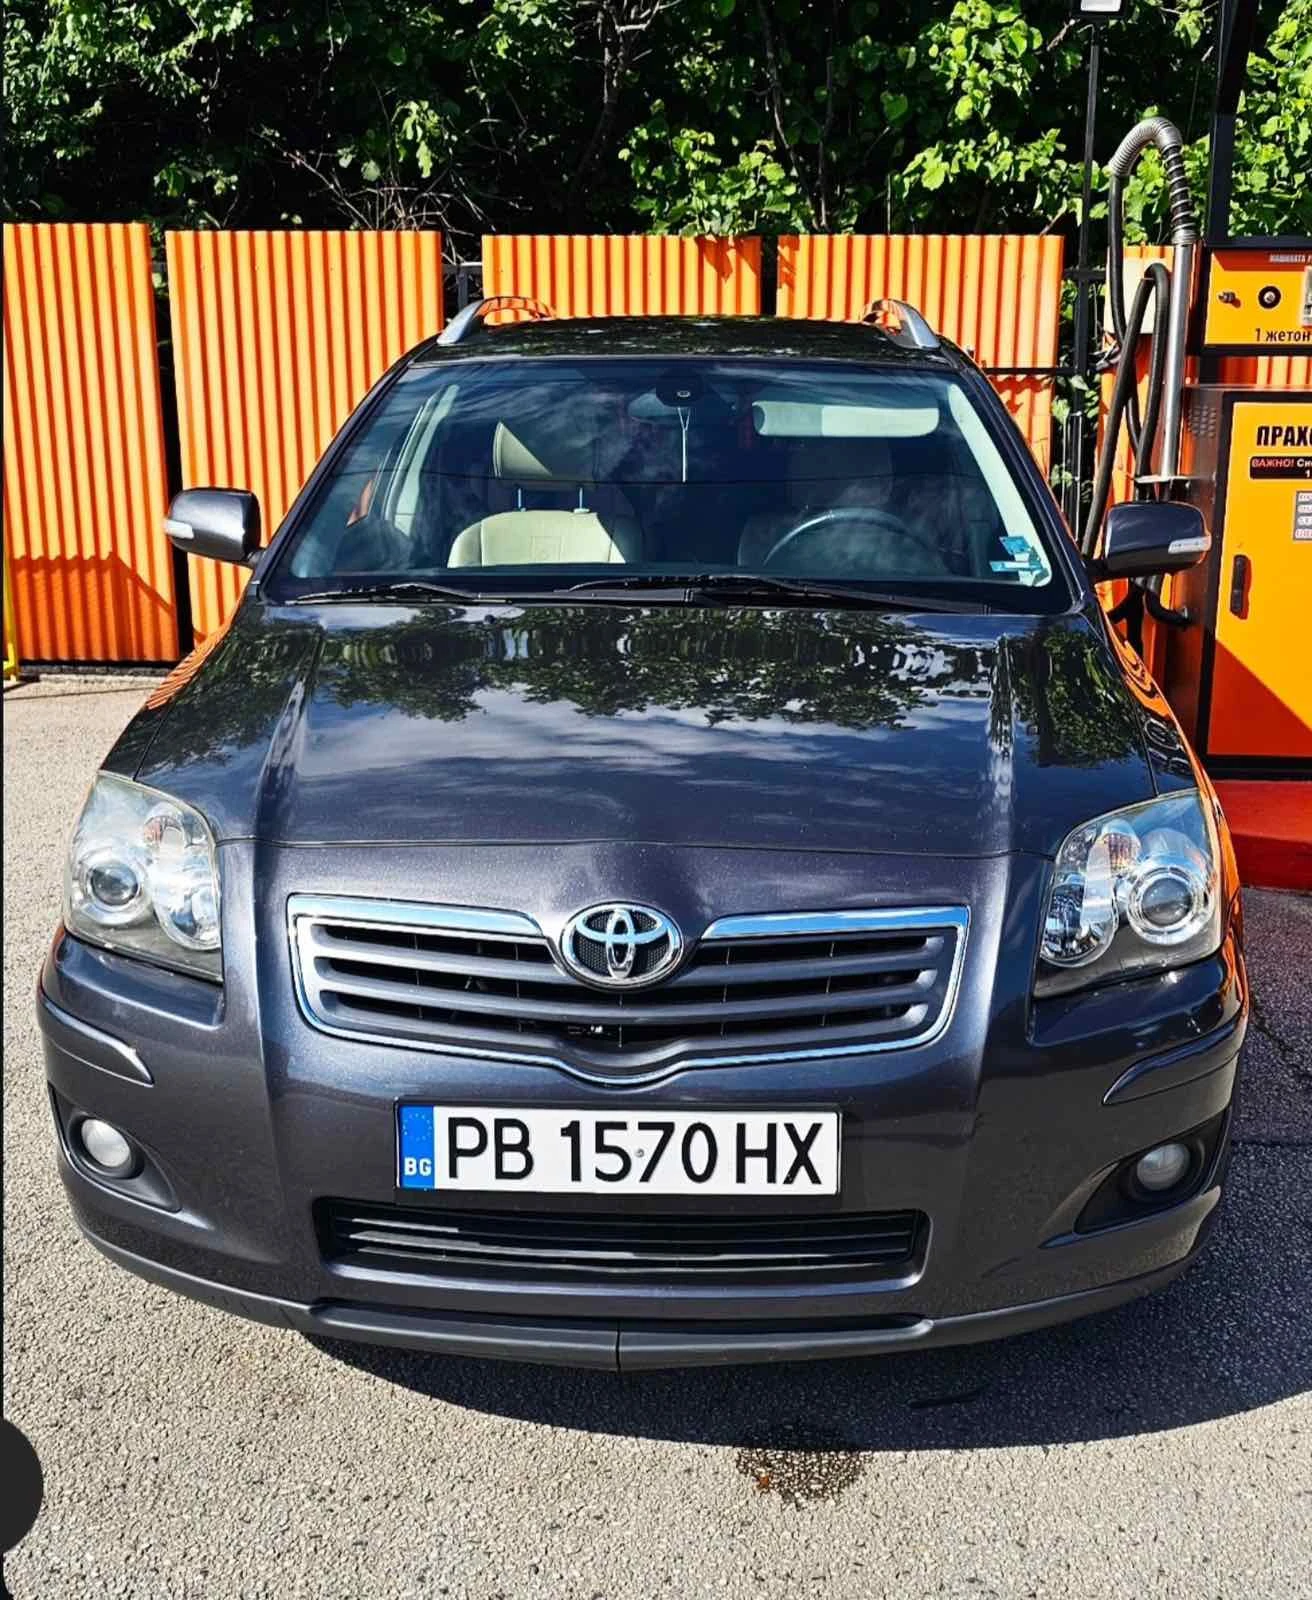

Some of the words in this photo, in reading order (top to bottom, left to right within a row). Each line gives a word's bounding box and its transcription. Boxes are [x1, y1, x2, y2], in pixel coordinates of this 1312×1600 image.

[1255, 327, 1261, 342] 1
[1265, 331, 1310, 342] жетон
[1256, 426, 1312, 446] ПРАХ
[1252, 458, 1294, 468] ВАЖНО!
[447, 1116, 534, 1180] PB
[560, 1119, 719, 1184] 1570
[736, 1122, 824, 1185] HX
[404, 1157, 432, 1176] BG
